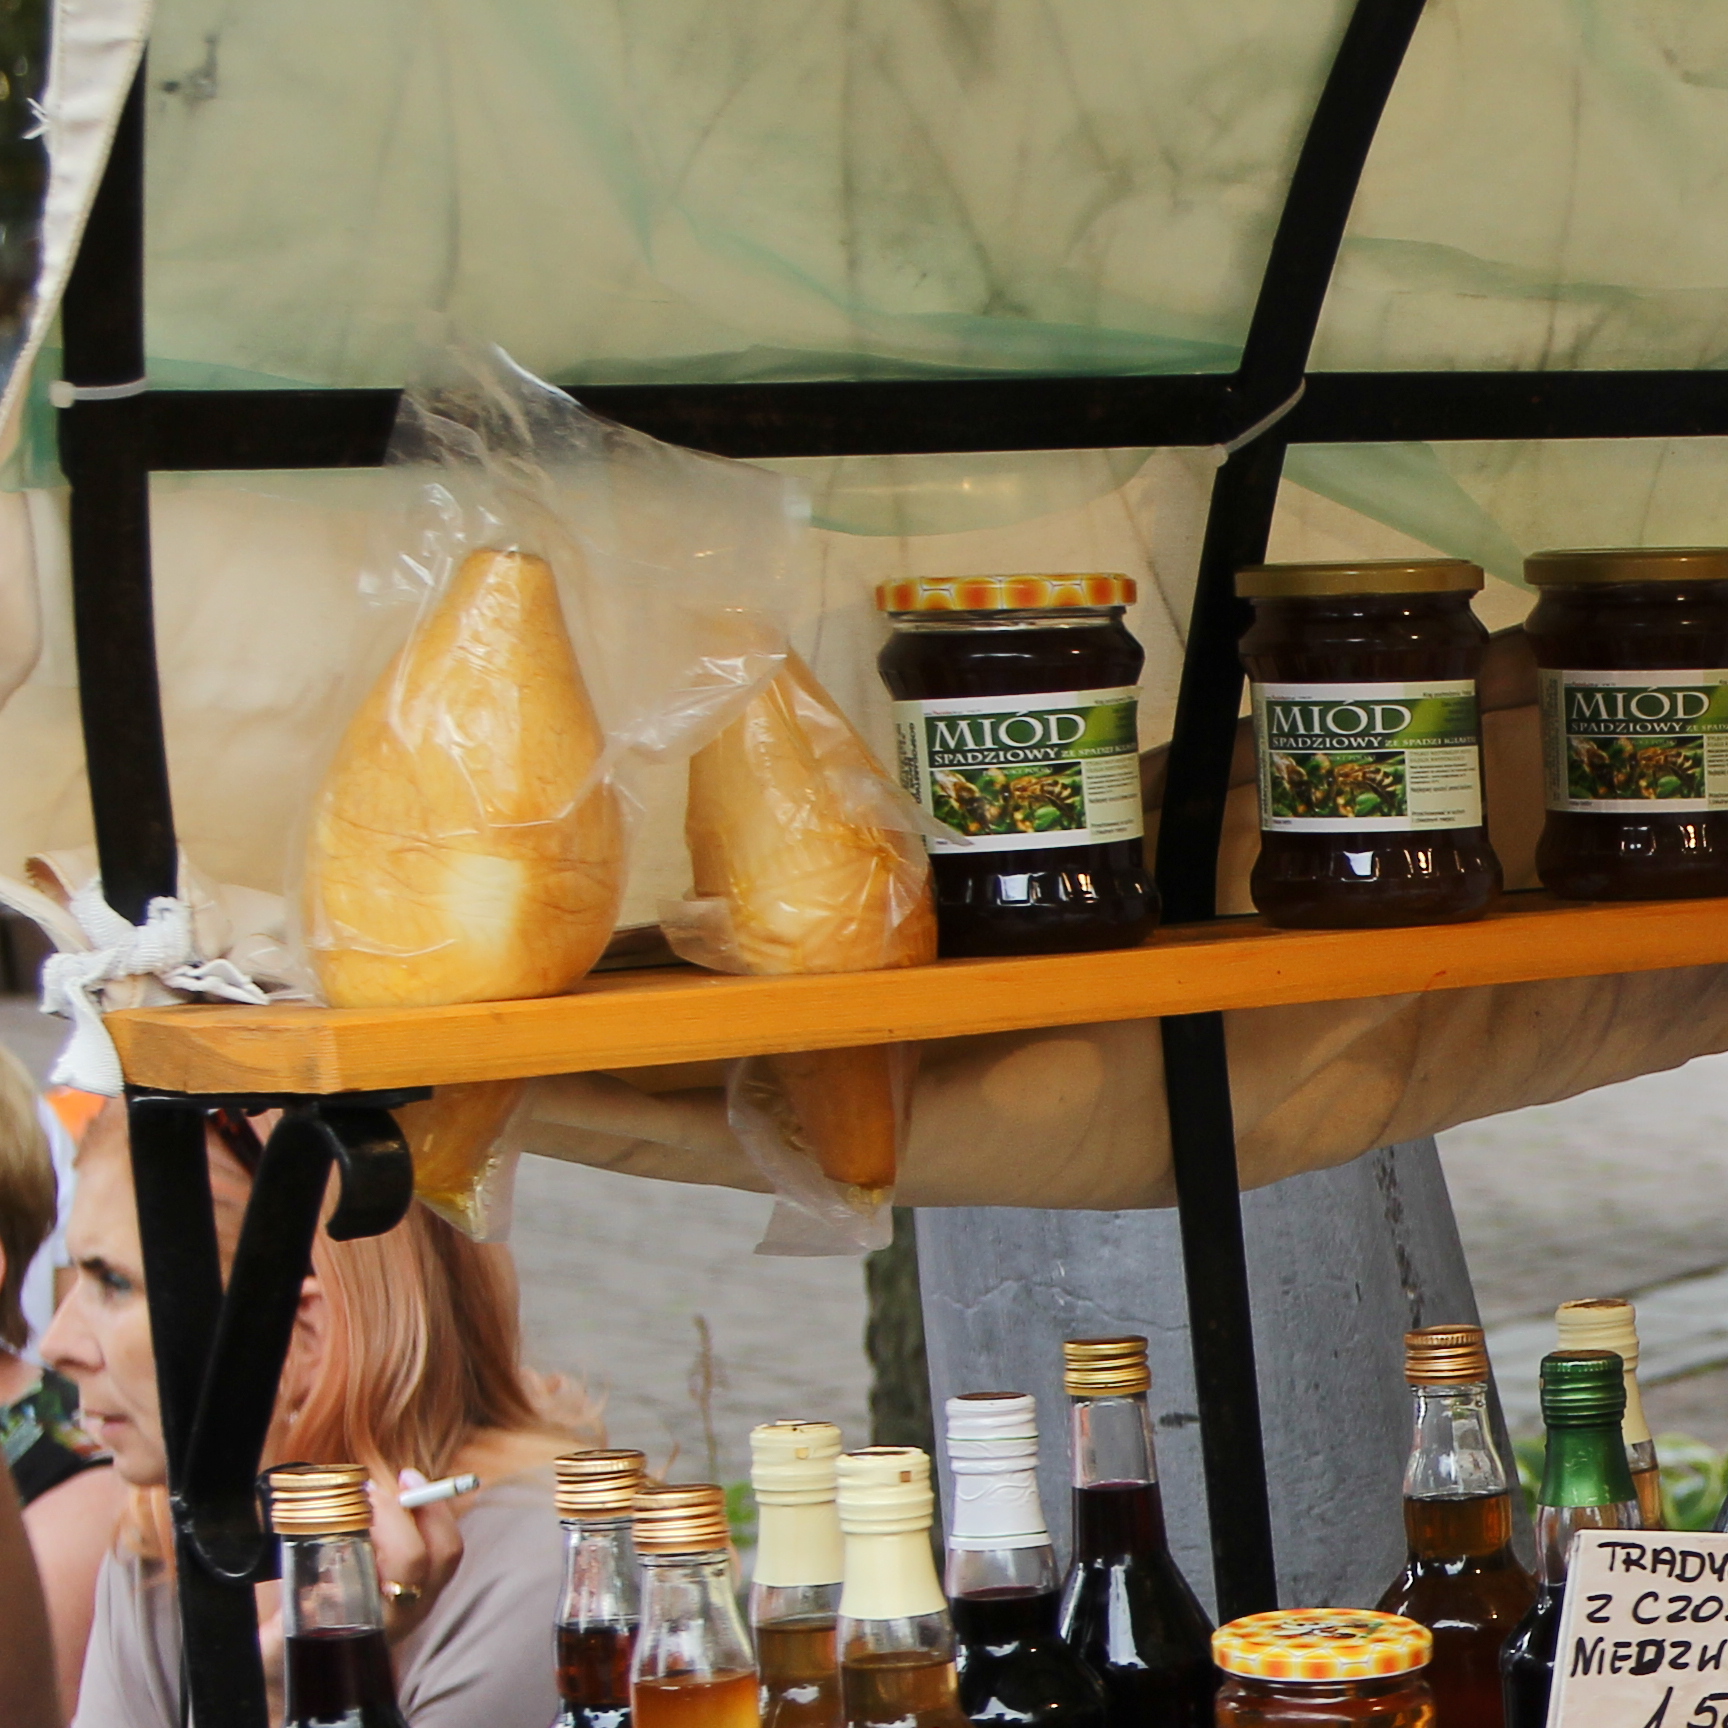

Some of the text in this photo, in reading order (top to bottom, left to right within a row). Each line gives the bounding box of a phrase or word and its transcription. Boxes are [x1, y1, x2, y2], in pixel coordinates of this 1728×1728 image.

[1272, 699, 1412, 735] MIÓD
[1571, 686, 1710, 720] MIÓD
[932, 710, 1086, 751] MIÓD
[1571, 721, 1683, 733] SPADZIOWY
[934, 747, 1059, 766] SPADZIOWY
[1272, 736, 1382, 749] SPADZIOWY
[1403, 737, 1442, 747] SPADZI
[1585, 1594, 1611, 1624] Z
